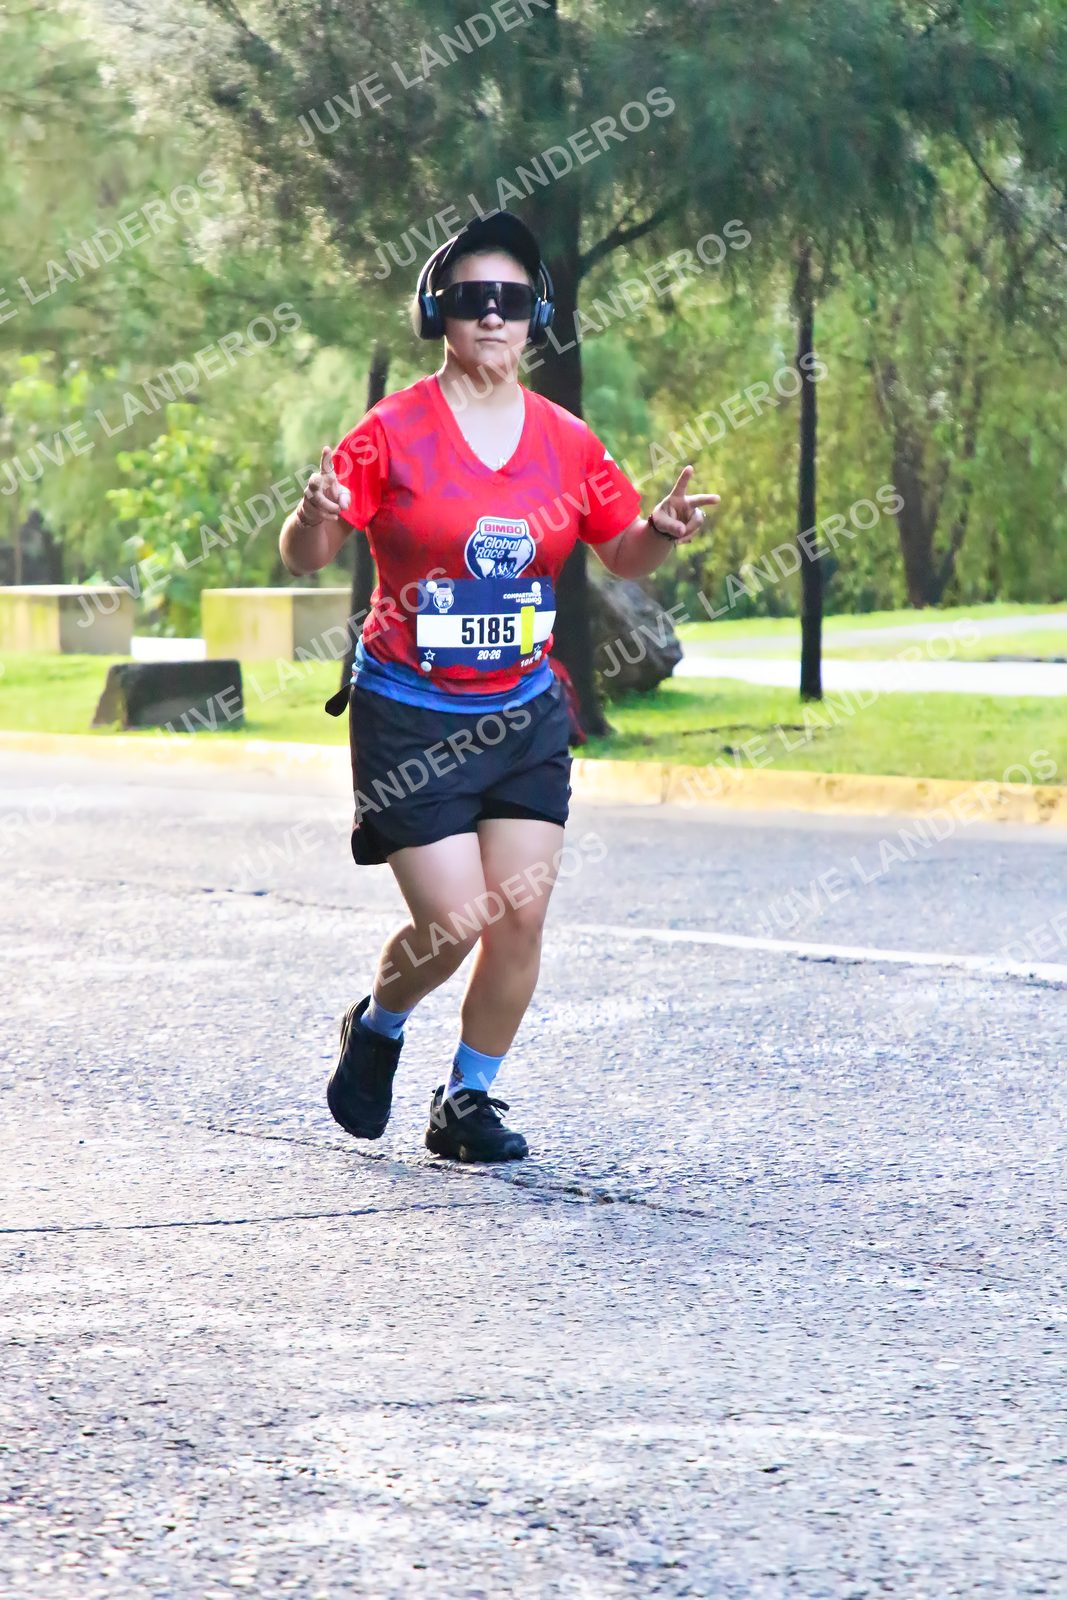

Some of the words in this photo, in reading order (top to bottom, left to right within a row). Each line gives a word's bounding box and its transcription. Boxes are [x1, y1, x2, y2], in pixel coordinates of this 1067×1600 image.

[484, 523, 522, 535] BIMBO
[484, 537, 522, 550] Global
[475, 547, 505, 559] Race
[461, 617, 516, 645] 5185
